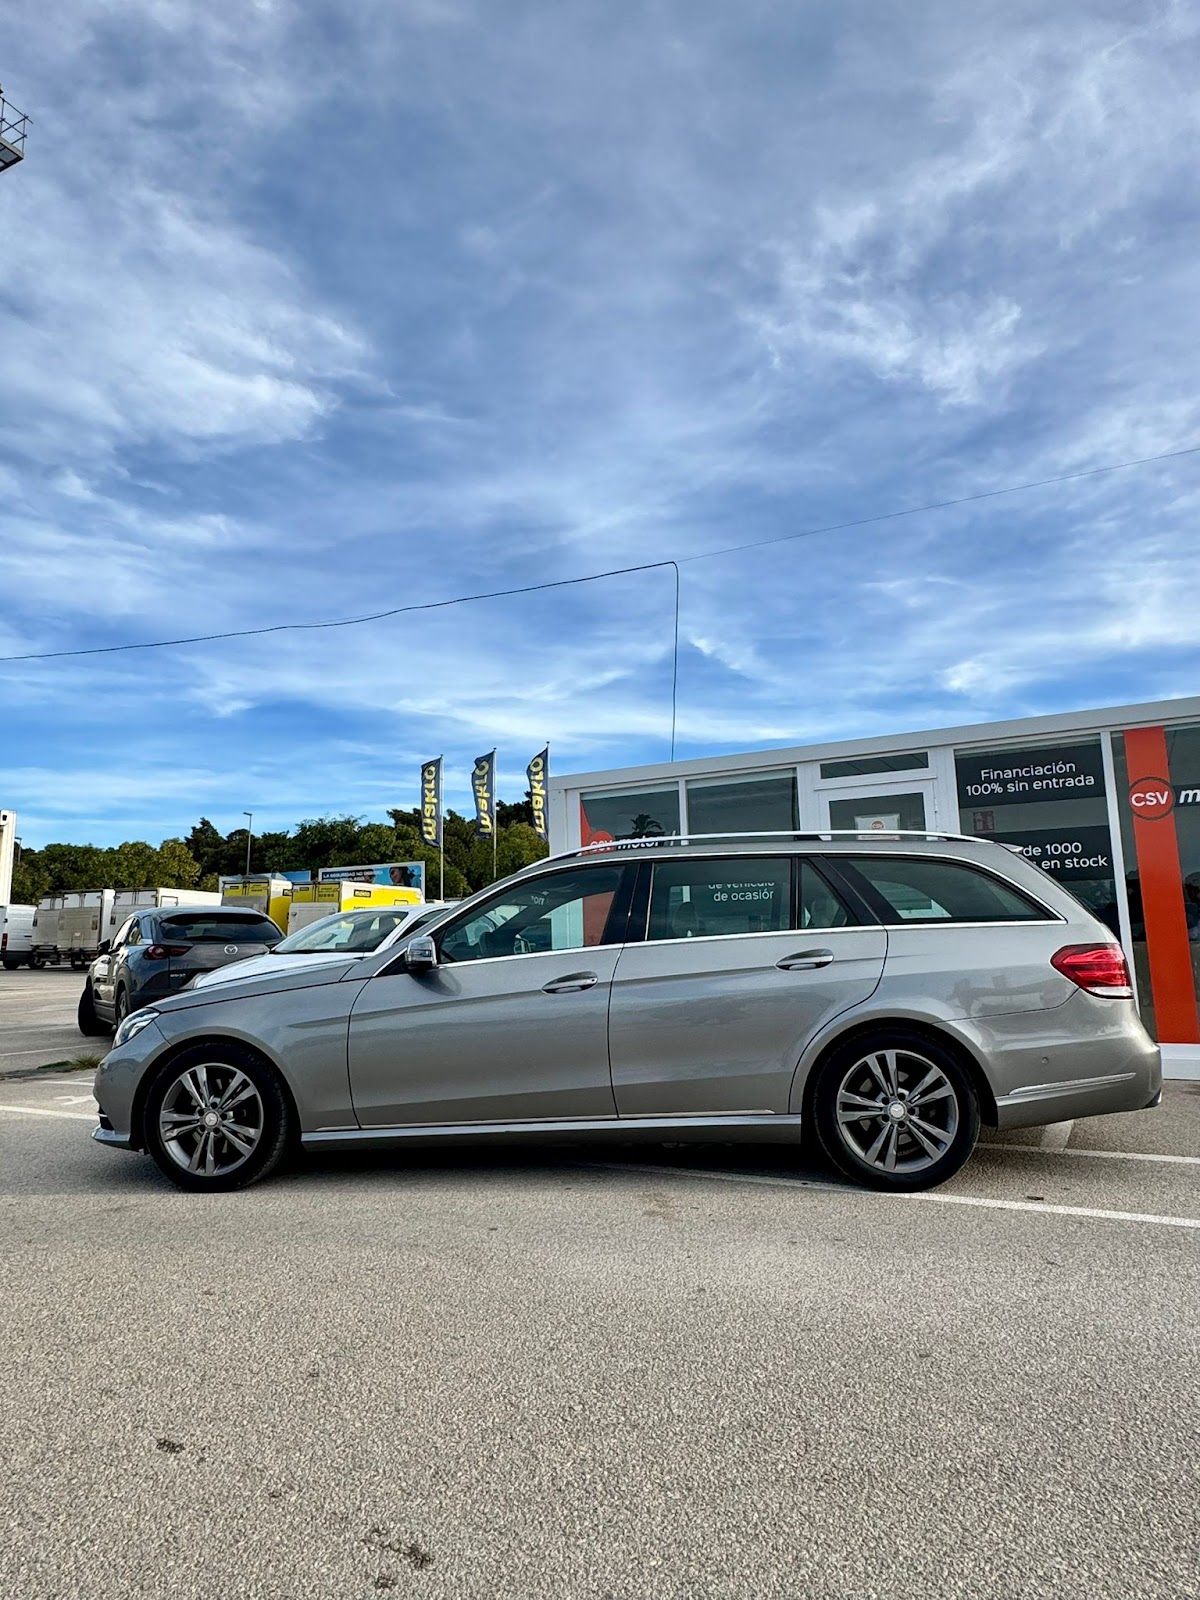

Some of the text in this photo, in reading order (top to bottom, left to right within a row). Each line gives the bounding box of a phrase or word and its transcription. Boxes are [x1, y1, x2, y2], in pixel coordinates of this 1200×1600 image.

[980, 761, 1076, 781] Financiación
[965, 774, 1095, 796] 100% sin entrada
[1131, 790, 1169, 807] CSV
[1045, 842, 1083, 855] 1000
[1041, 855, 1108, 870] en stock
[713, 891, 728, 902] de
